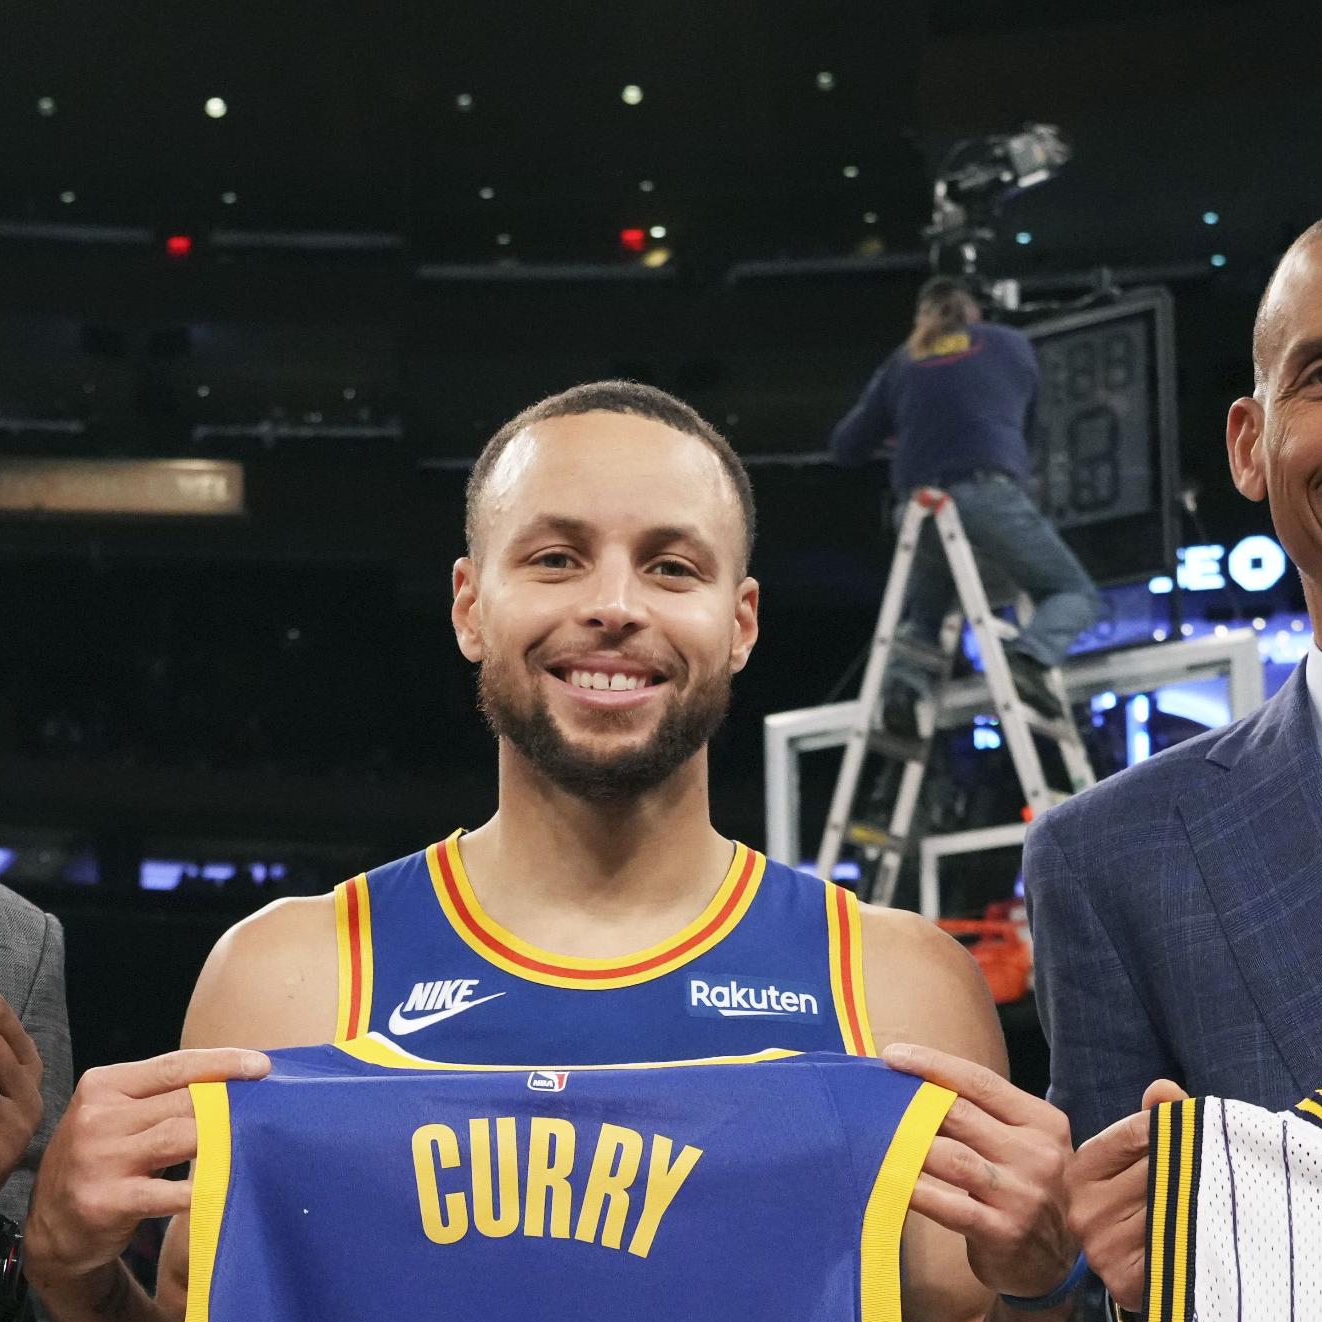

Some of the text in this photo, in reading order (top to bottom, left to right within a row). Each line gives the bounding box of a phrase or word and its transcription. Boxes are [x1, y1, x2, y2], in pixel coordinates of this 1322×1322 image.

[402, 979, 479, 1012] NIKE
[690, 979, 819, 1015] Rakuten
[532, 1079, 554, 1088] NBA
[411, 1116, 704, 1259] CURRY
